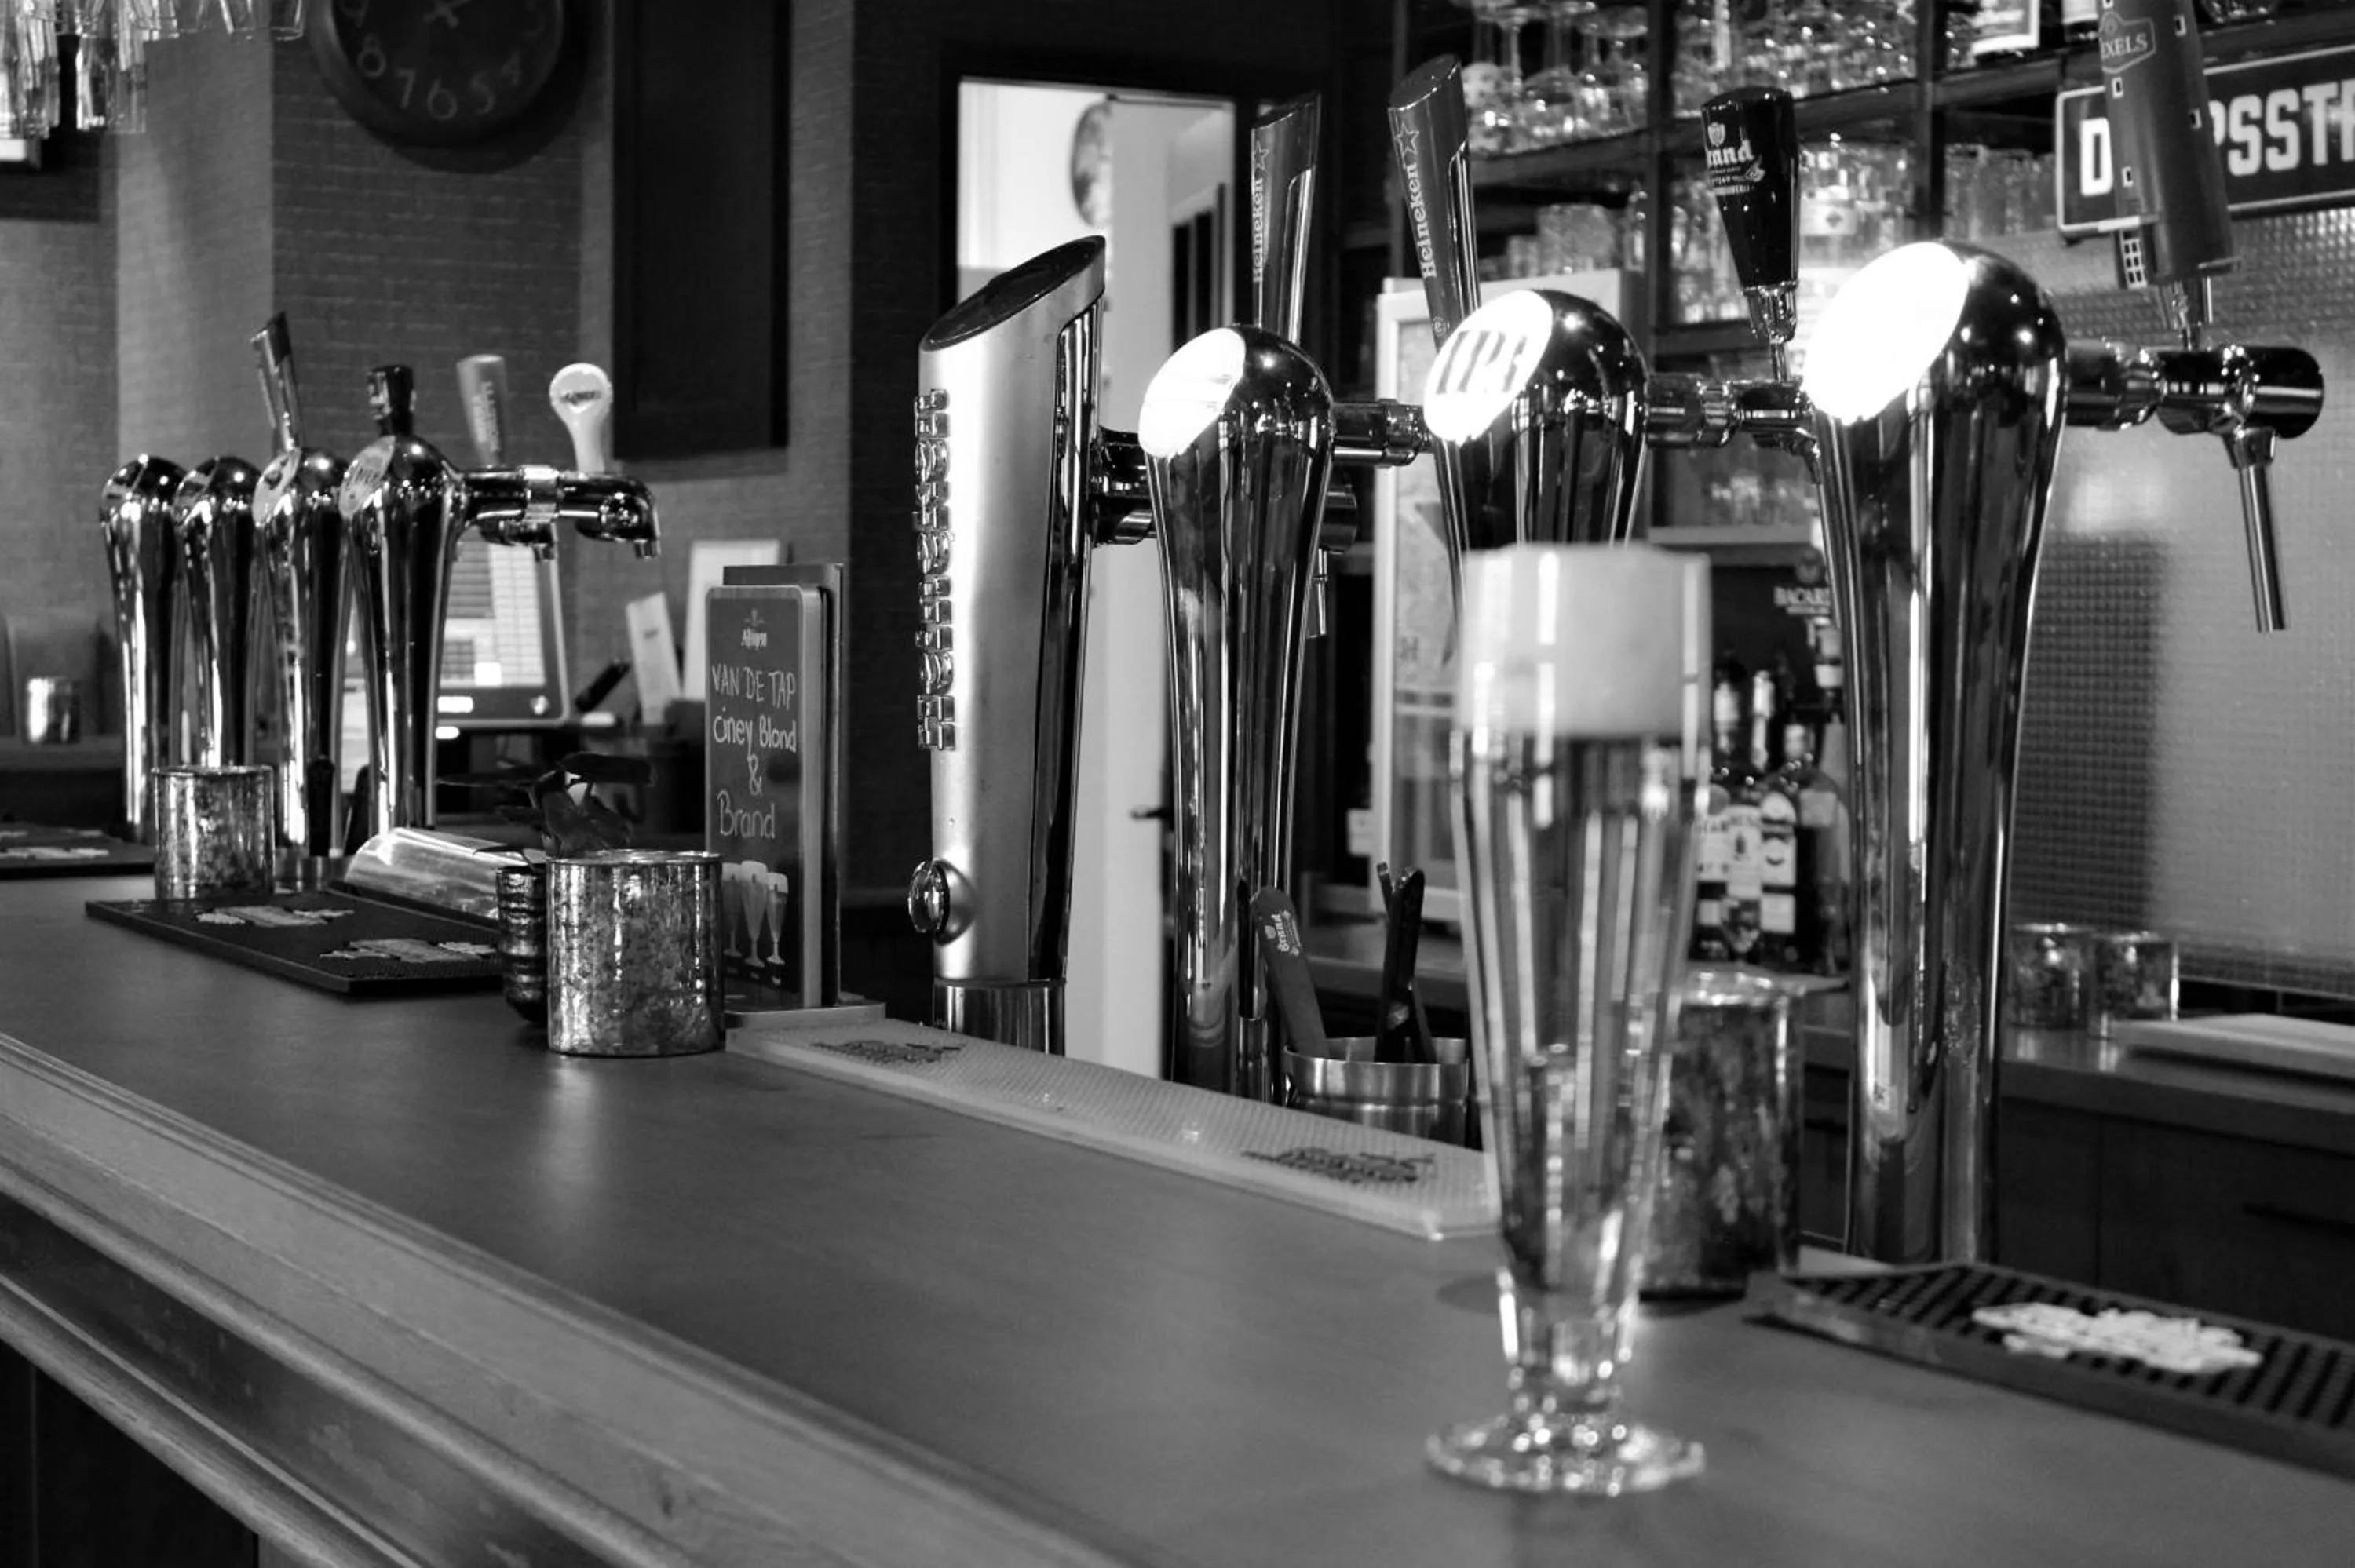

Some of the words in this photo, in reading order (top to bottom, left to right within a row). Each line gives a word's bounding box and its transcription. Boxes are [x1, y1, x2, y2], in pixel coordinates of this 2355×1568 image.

[357, 32, 387, 77] 8
[502, 49, 522, 86] 4
[396, 67, 418, 110] 7
[427, 78, 458, 121] 6
[469, 69, 496, 115] 5
[2079, 78, 2355, 197] DSST
[1251, 177, 1264, 283] Heineken
[1405, 162, 1437, 279] Heineken
[711, 663, 739, 696] VAN
[743, 665, 765, 703] DE
[768, 669, 797, 711] TAP
[759, 715, 797, 753] Blond
[748, 753, 763, 798] &
[717, 789, 776, 840] Brand
